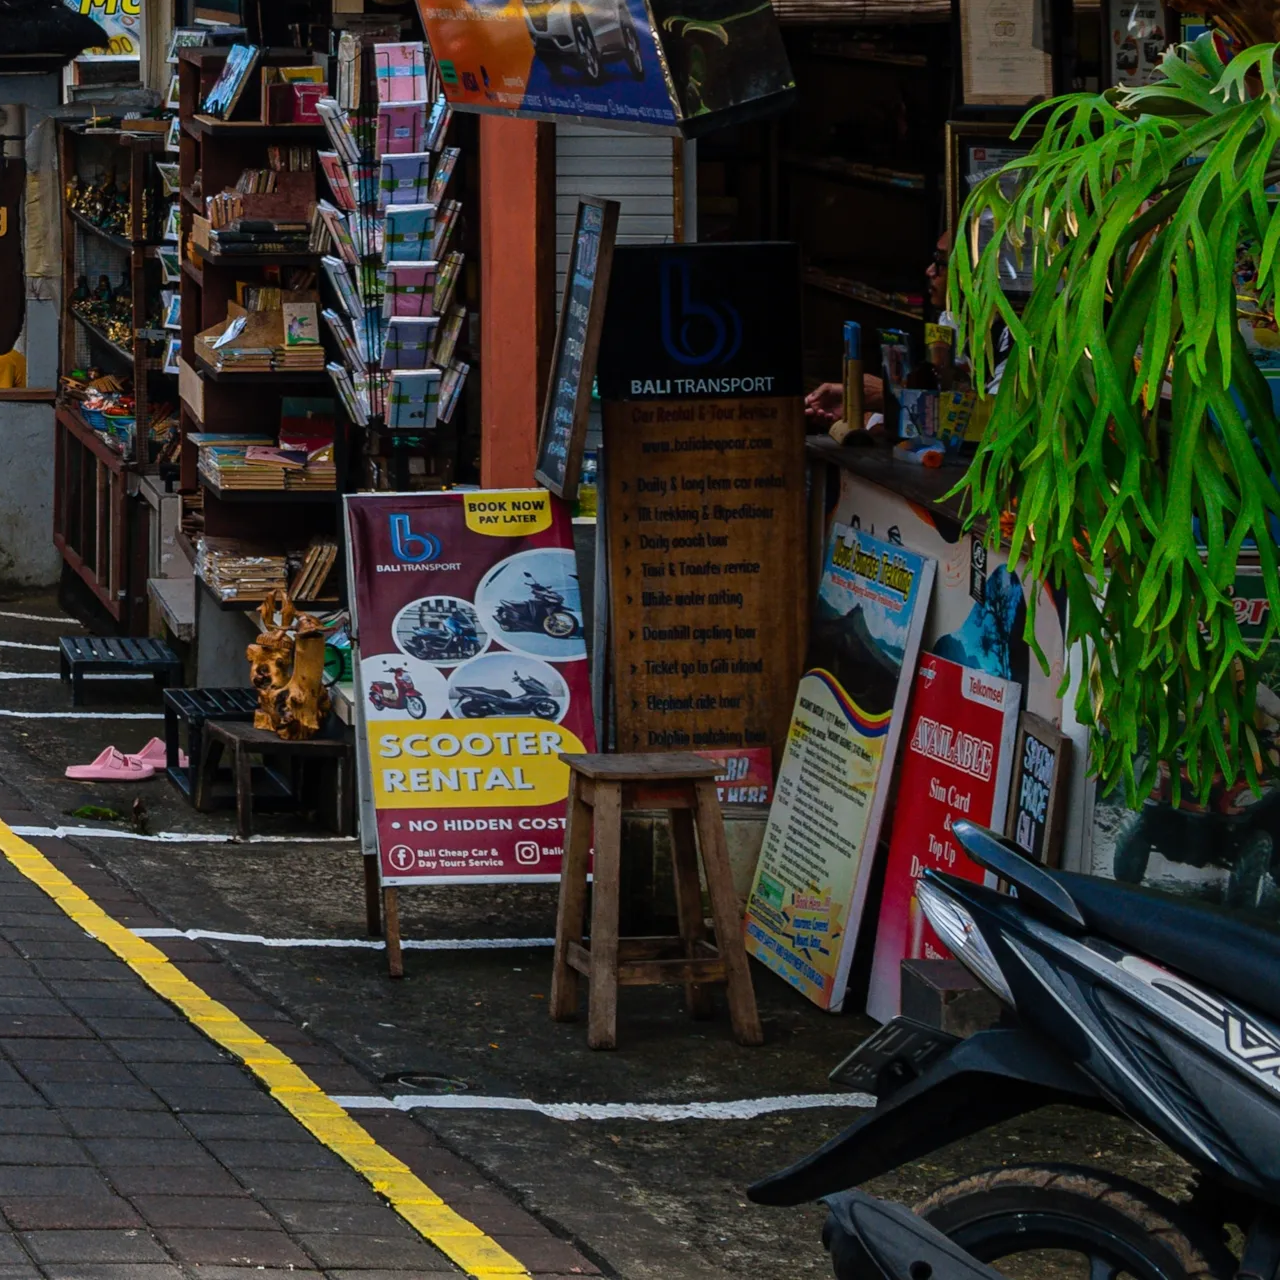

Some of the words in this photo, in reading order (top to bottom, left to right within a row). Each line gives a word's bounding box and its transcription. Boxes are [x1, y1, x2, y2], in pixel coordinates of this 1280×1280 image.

[630, 379, 671, 395] BALI
[674, 376, 775, 394] TRANSPORT
[637, 477, 667, 496] Daily
[681, 476, 705, 495] long
[707, 475, 731, 491] term
[734, 477, 752, 490] car
[753, 474, 786, 489] rental
[468, 500, 508, 513] BOOK
[512, 499, 546, 511] NOW
[654, 504, 699, 526] trekking
[478, 515, 499, 525] PAY
[501, 513, 537, 524] LATER
[639, 534, 669, 553] Daily
[707, 532, 728, 547] tour
[376, 564, 401, 573] BALI
[401, 562, 462, 572] TRANSPORT
[724, 559, 760, 575] service
[641, 591, 672, 607] White
[675, 591, 705, 606] water
[642, 625, 690, 641] Downhill
[692, 625, 732, 644] cycling
[734, 624, 757, 640] tour
[644, 659, 679, 676] Ticket
[681, 662, 696, 679] go
[697, 659, 709, 675] to
[968, 676, 1004, 705] Telkomsel
[647, 694, 694, 716] Elephant
[696, 693, 717, 710] ride
[719, 694, 741, 709] tour
[378, 730, 565, 759] SCOOTER
[910, 715, 994, 782] AVAILABLE
[382, 766, 536, 793] RENTAL
[929, 776, 947, 804] Sim
[947, 784, 972, 814] Card
[408, 819, 439, 832] NO
[443, 818, 513, 831] HIDDEN
[417, 848, 437, 858] Bali
[438, 848, 470, 859] Cheap
[471, 848, 489, 857] Car
[491, 848, 499, 857] &
[928, 833, 944, 857] Top
[943, 843, 956, 868] Up
[418, 859, 437, 870] Day
[439, 858, 466, 868] Tours
[467, 858, 504, 867] Service
